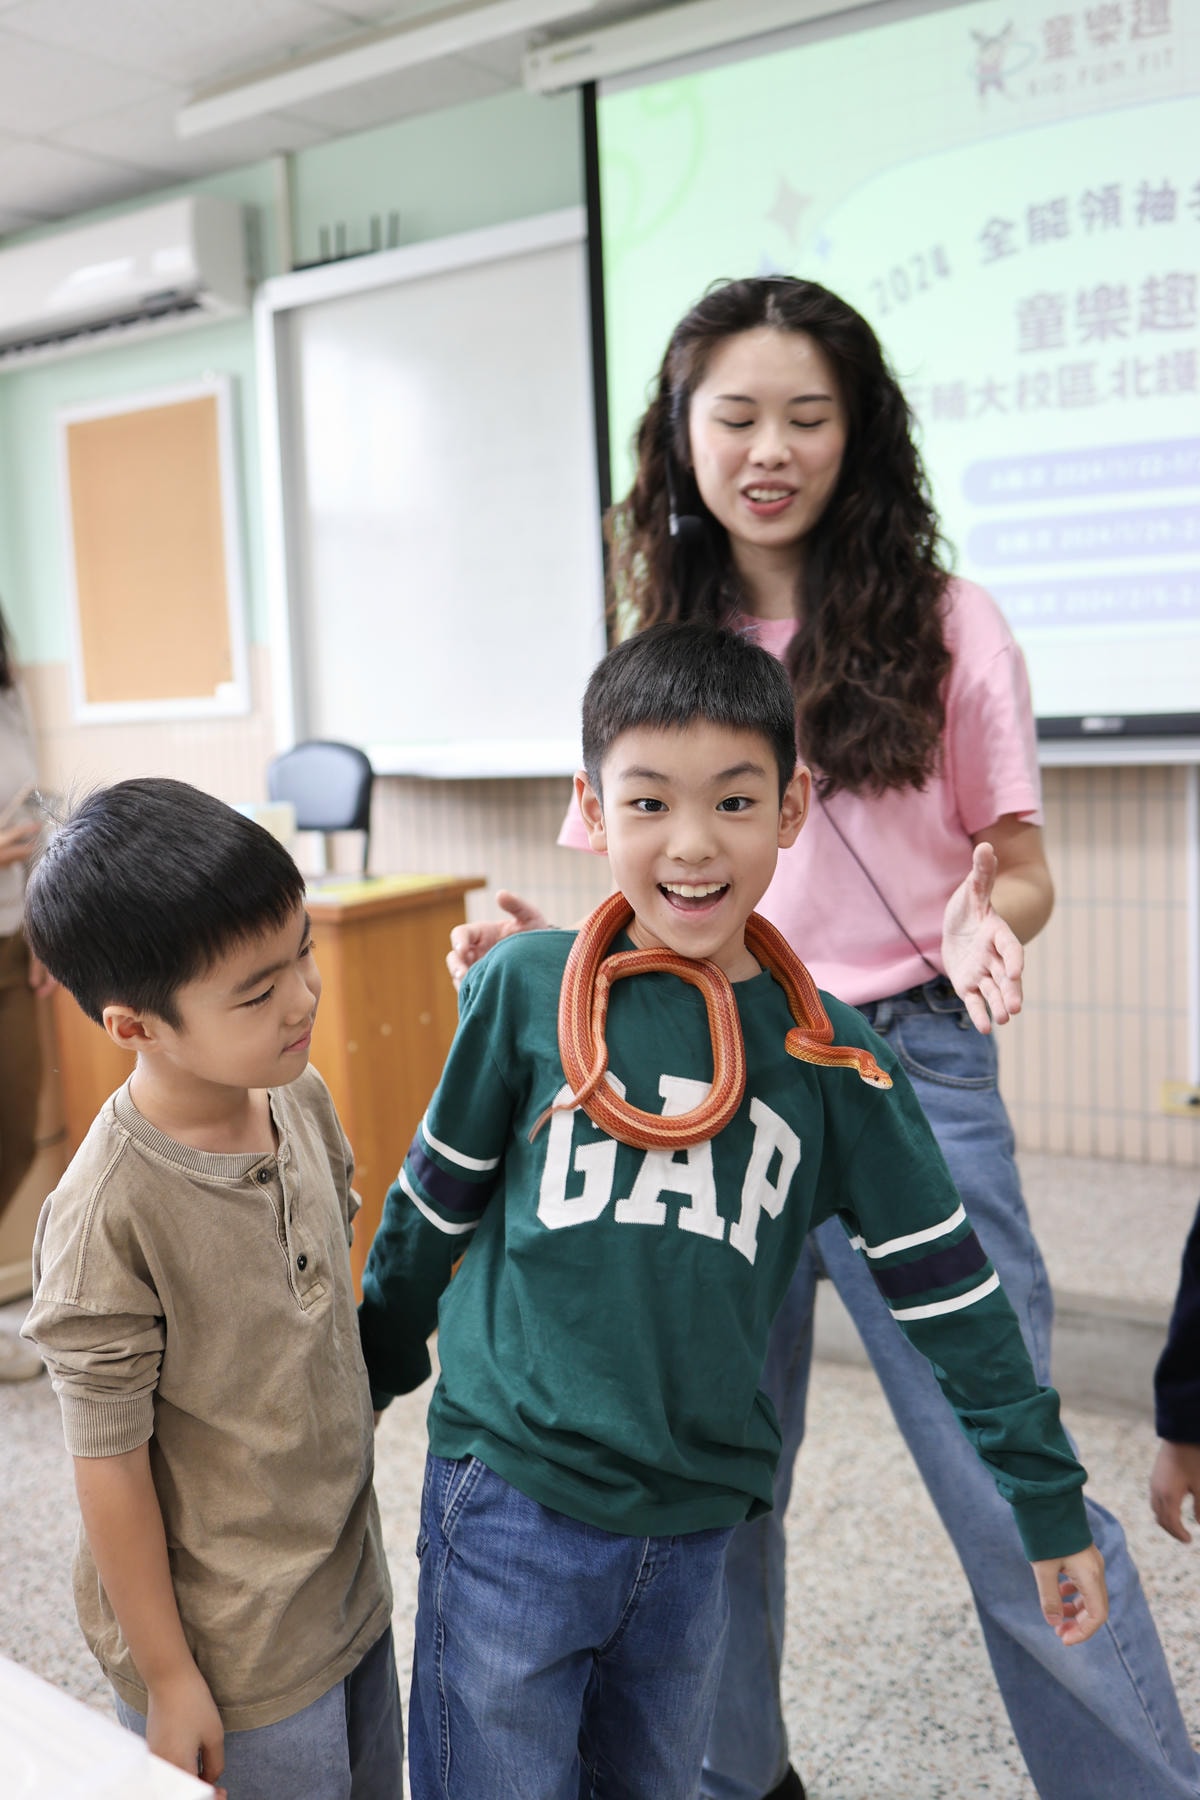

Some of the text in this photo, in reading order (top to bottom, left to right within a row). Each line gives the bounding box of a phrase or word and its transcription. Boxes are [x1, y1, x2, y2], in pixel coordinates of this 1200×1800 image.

[1015, 272, 1198, 354] 童樂趣
[536, 1070, 801, 1266] GAP
